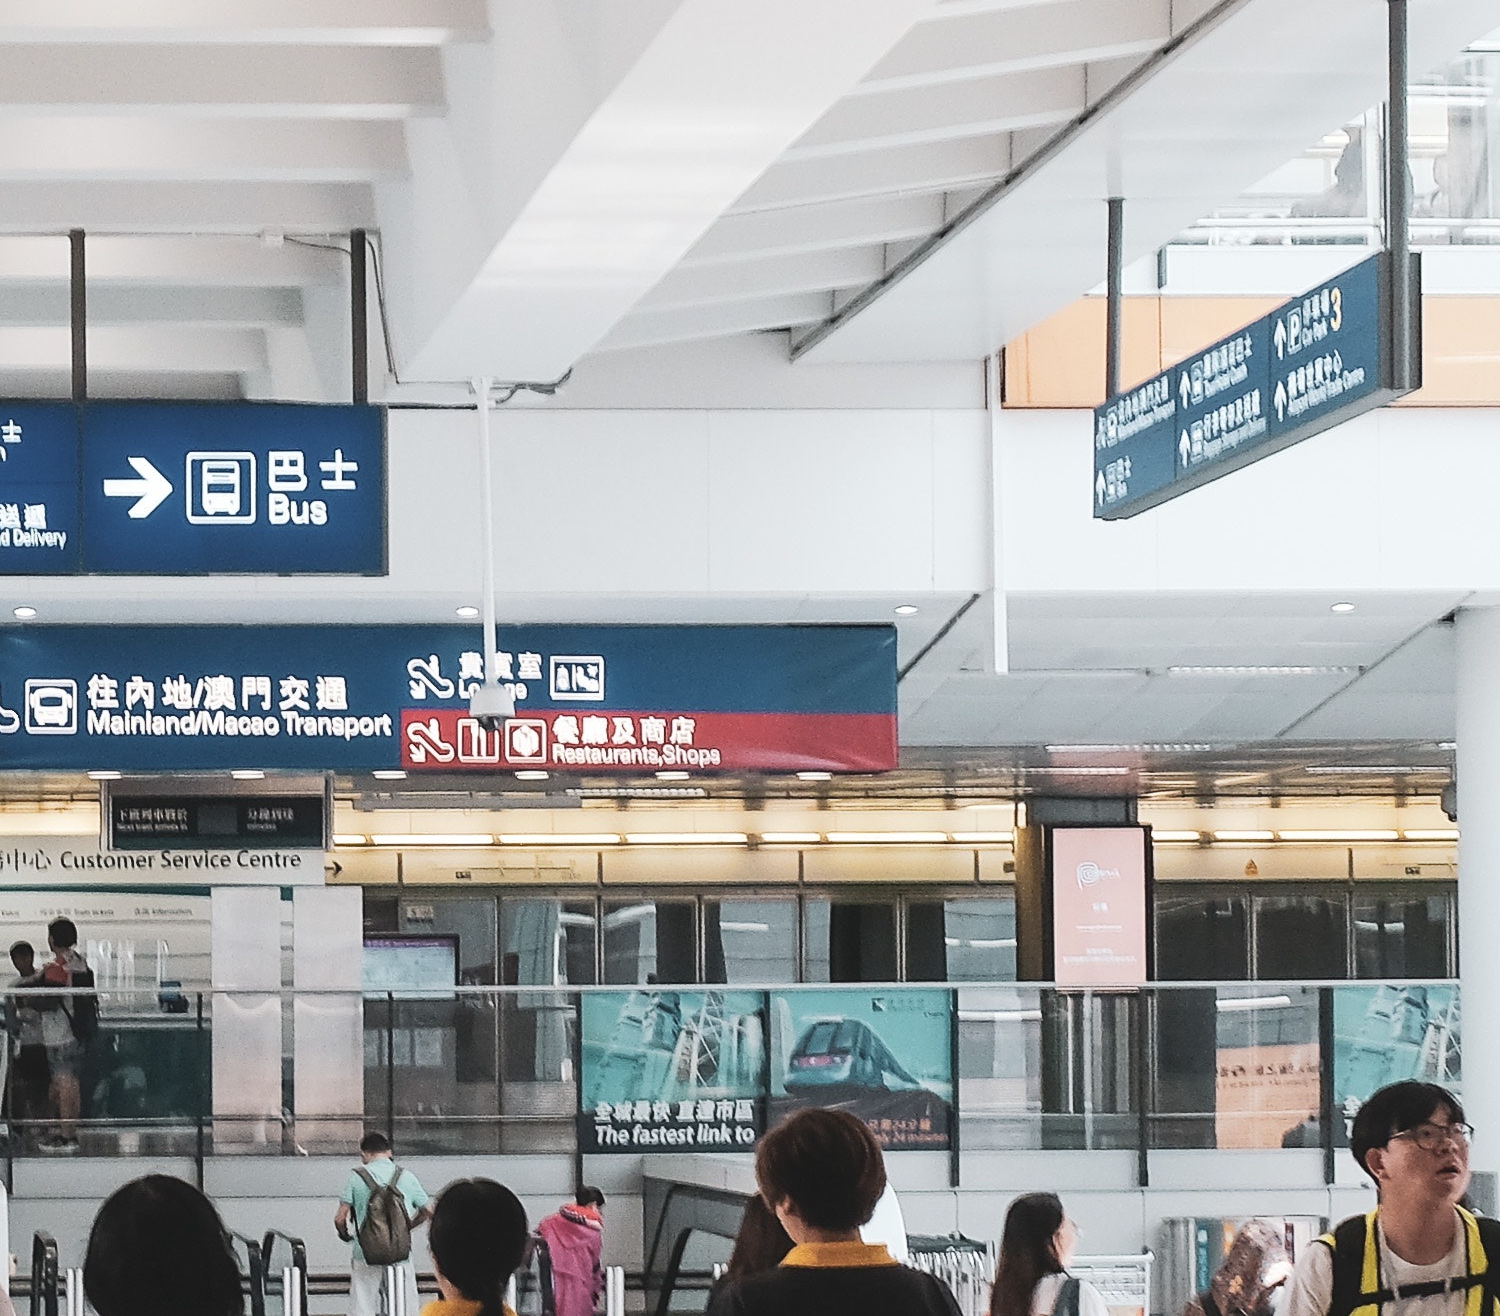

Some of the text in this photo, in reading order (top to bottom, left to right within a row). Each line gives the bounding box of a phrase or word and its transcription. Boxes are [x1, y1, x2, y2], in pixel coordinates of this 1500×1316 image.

[268, 448, 359, 492] 巴士
[268, 492, 328, 525] Bus
[12, 528, 67, 551] Delivery
[86, 673, 348, 711] 往內地/澳門交通
[458, 678, 528, 701] Loge
[86, 709, 393, 742] Mainland/Macao Transport
[552, 714, 697, 745] 餐廳及商店
[60, 848, 302, 871] Customer Service Centre
[595, 1123, 756, 1146] The fastest link to
